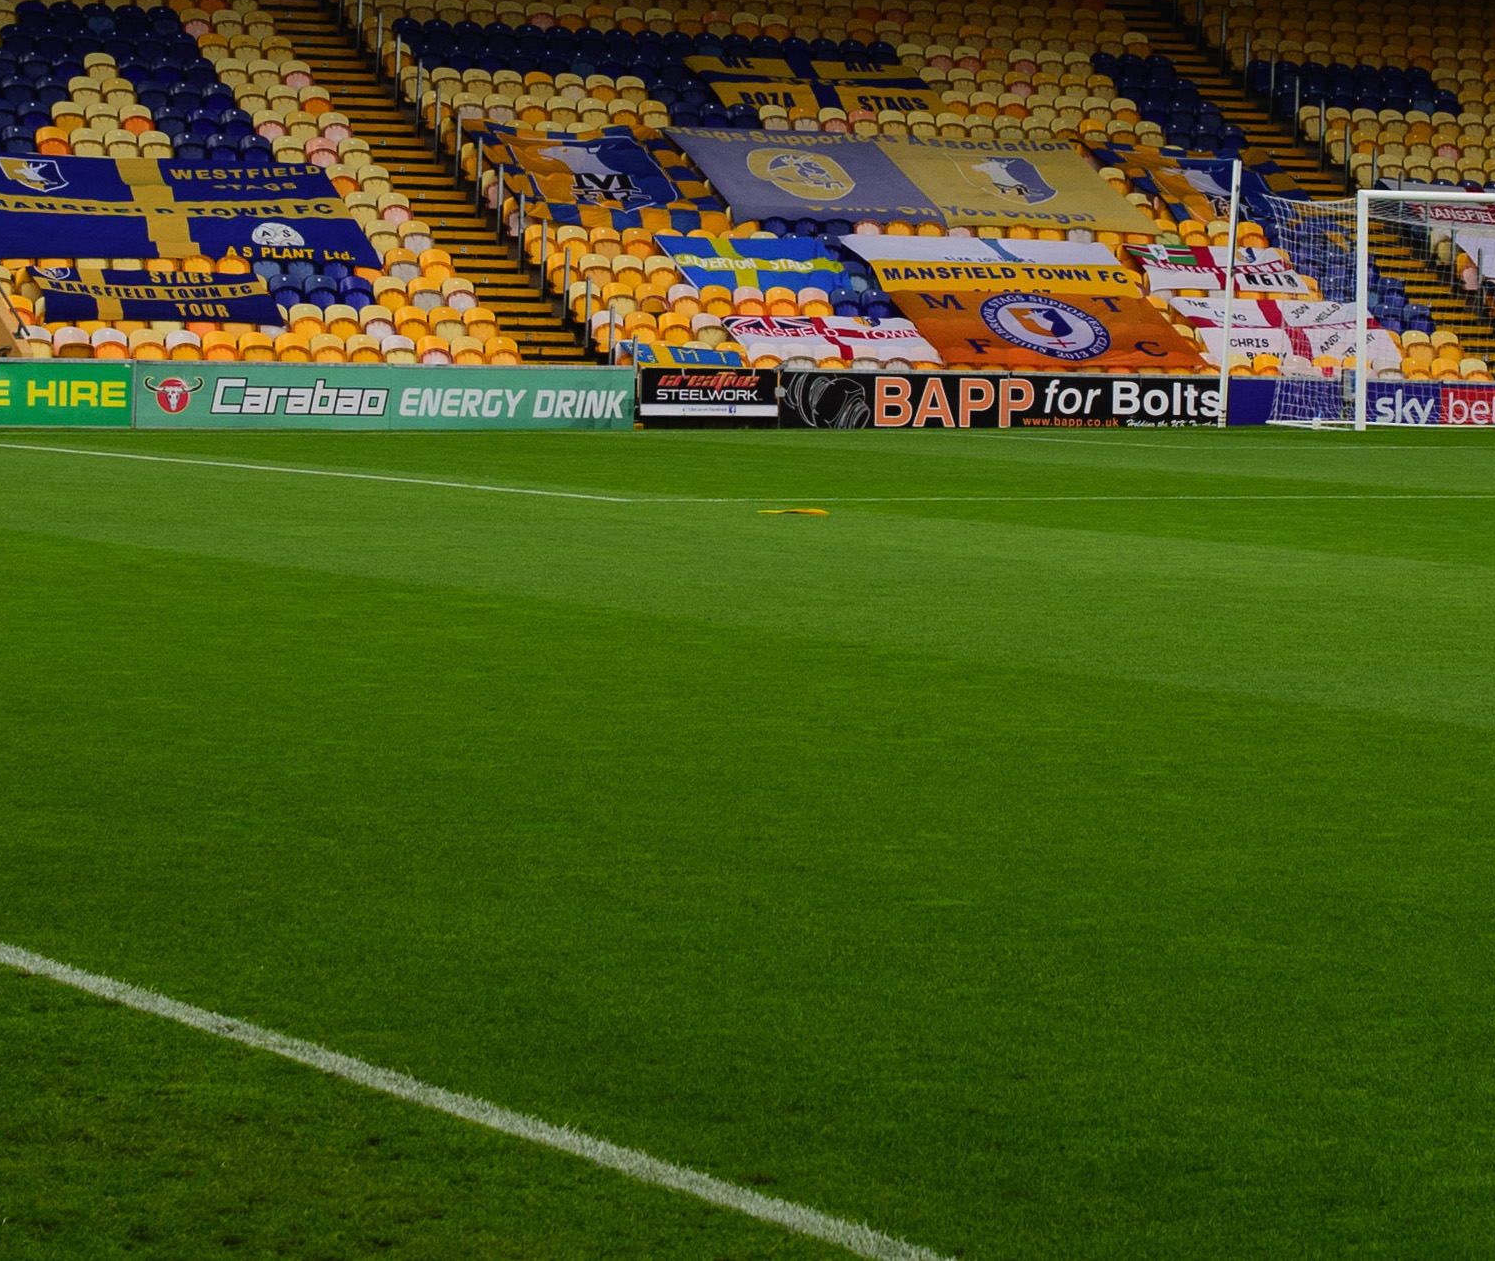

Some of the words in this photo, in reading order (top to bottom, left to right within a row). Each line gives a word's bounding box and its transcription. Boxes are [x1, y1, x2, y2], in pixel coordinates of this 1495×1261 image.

[857, 95, 929, 111] STAGS
[907, 134, 1074, 152] Association
[170, 166, 321, 180] WESTFIELD
[294, 204, 334, 215] FC
[226, 246, 237, 257] A
[242, 247, 253, 258] S
[261, 247, 314, 259] PLANT
[324, 250, 356, 261] Ltd.
[675, 254, 757, 271] CALVERTON
[150, 271, 214, 285] STAGS
[882, 267, 1016, 282] MANSFIELD
[1021, 268, 1092, 282] TOWN
[1098, 270, 1129, 285] FC
[49, 281, 157, 299] MANSFIELD
[163, 286, 227, 300] TOWN
[232, 284, 253, 295] FC
[176, 302, 231, 319] TOUR
[917, 293, 965, 311] M
[1092, 296, 1121, 313] T
[988, 294, 1026, 309] STAGS
[1028, 295, 1107, 337] SUPPORTERS
[732, 325, 840, 338] MANSFIELD
[860, 329, 920, 340] TOWN
[966, 338, 992, 354] F
[1135, 340, 1169, 357] C
[1230, 338, 1269, 348] CHRIS
[27, 380, 126, 407] HIRE
[210, 376, 390, 416] Carabao
[399, 388, 526, 418] ENERGY
[532, 389, 628, 419] DRINK
[656, 389, 758, 401] STEELWORK
[874, 377, 1034, 428] BAPP
[1044, 379, 1102, 414] for
[1112, 381, 1223, 416] Bolts
[1375, 389, 1435, 424] sky
[1022, 416, 1119, 428] www.bapp.co.uk
